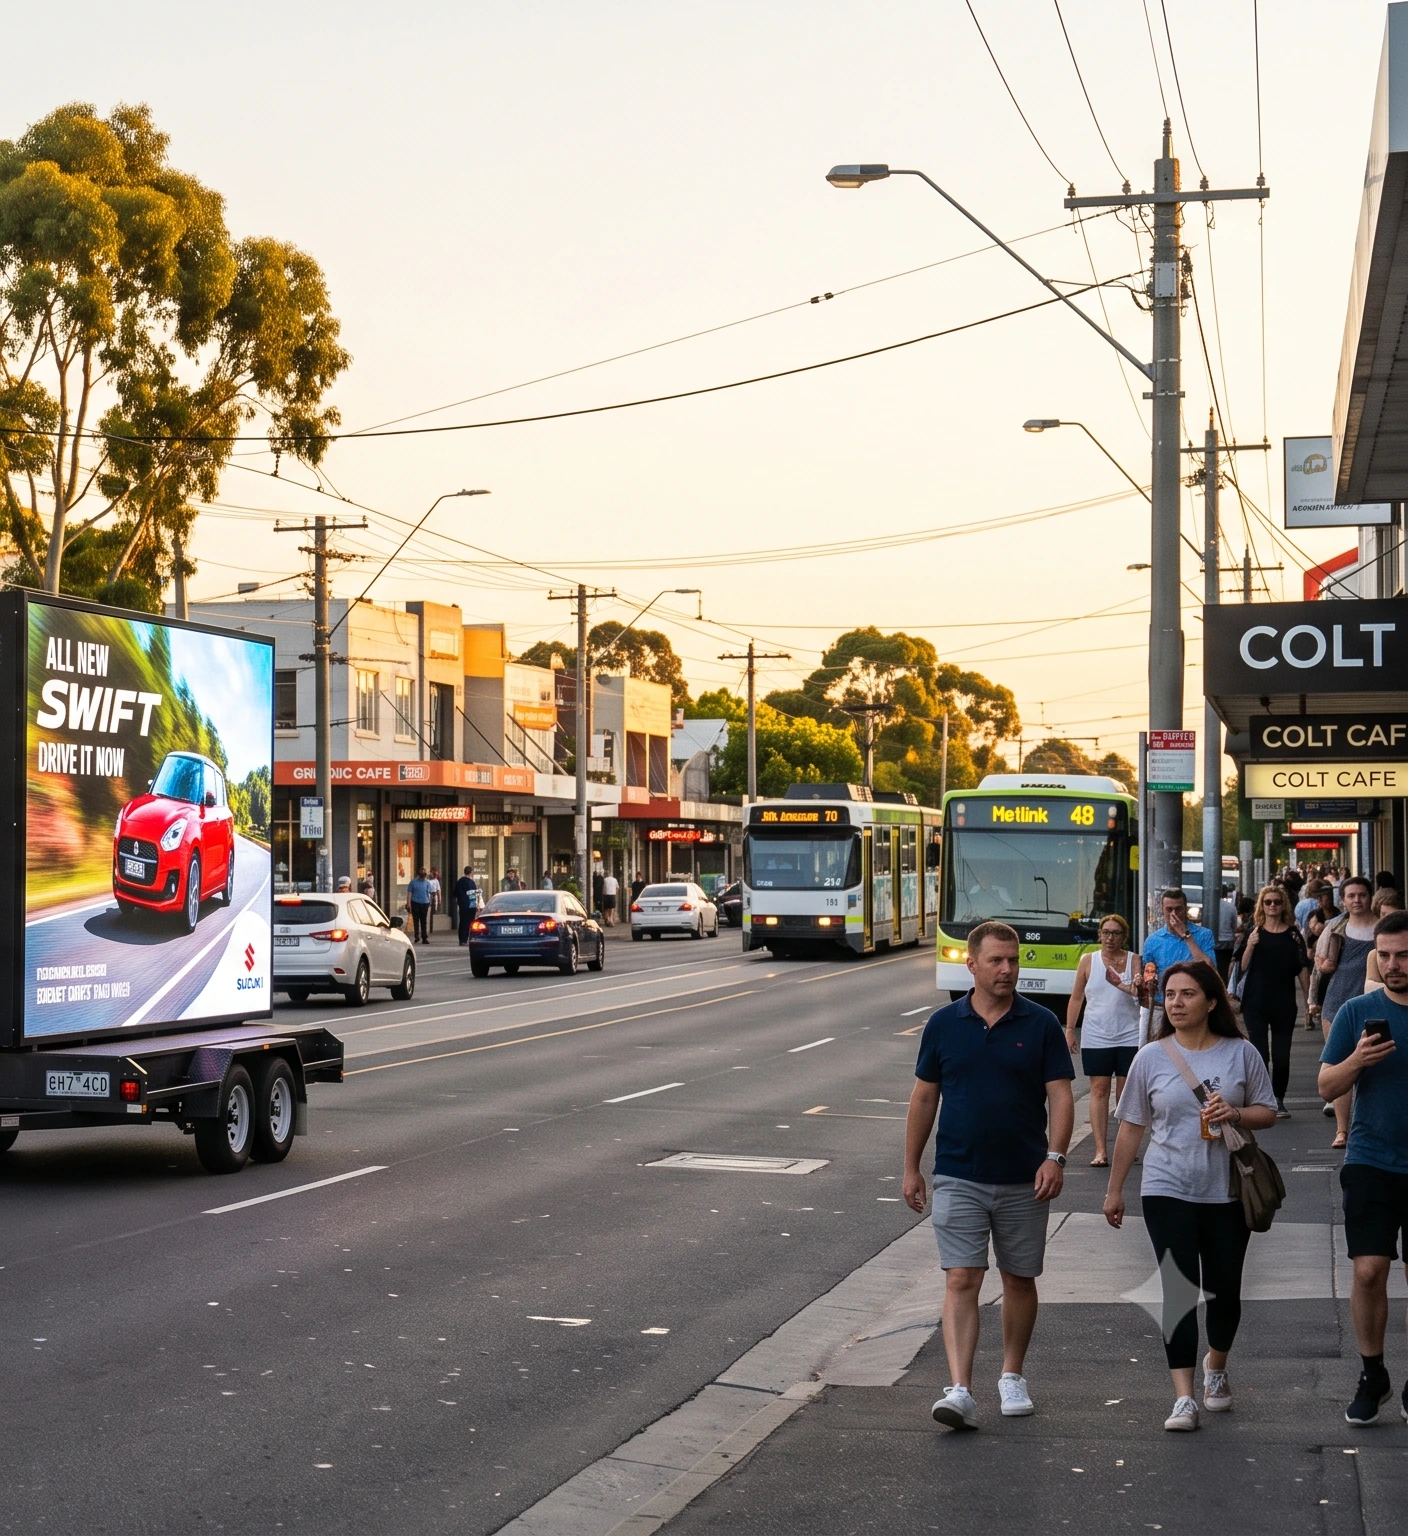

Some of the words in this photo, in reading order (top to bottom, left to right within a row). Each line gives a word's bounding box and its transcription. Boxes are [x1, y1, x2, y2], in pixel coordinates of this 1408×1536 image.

[46, 637, 74, 673] ALL
[77, 641, 109, 677] NEW
[1240, 623, 1396, 669] COLT
[36, 679, 162, 737] SWIFT
[1263, 726, 1339, 748] COLT
[38, 741, 77, 775] DRIVE
[80, 744, 94, 775] IT
[96, 747, 125, 777] NOW
[356, 768, 391, 779] CAFE
[1273, 771, 1329, 788] COLT
[1338, 770, 1396, 787] CAFE
[825, 811, 838, 822] 70
[992, 805, 1049, 824] Metlink
[1070, 805, 1095, 826] 48
